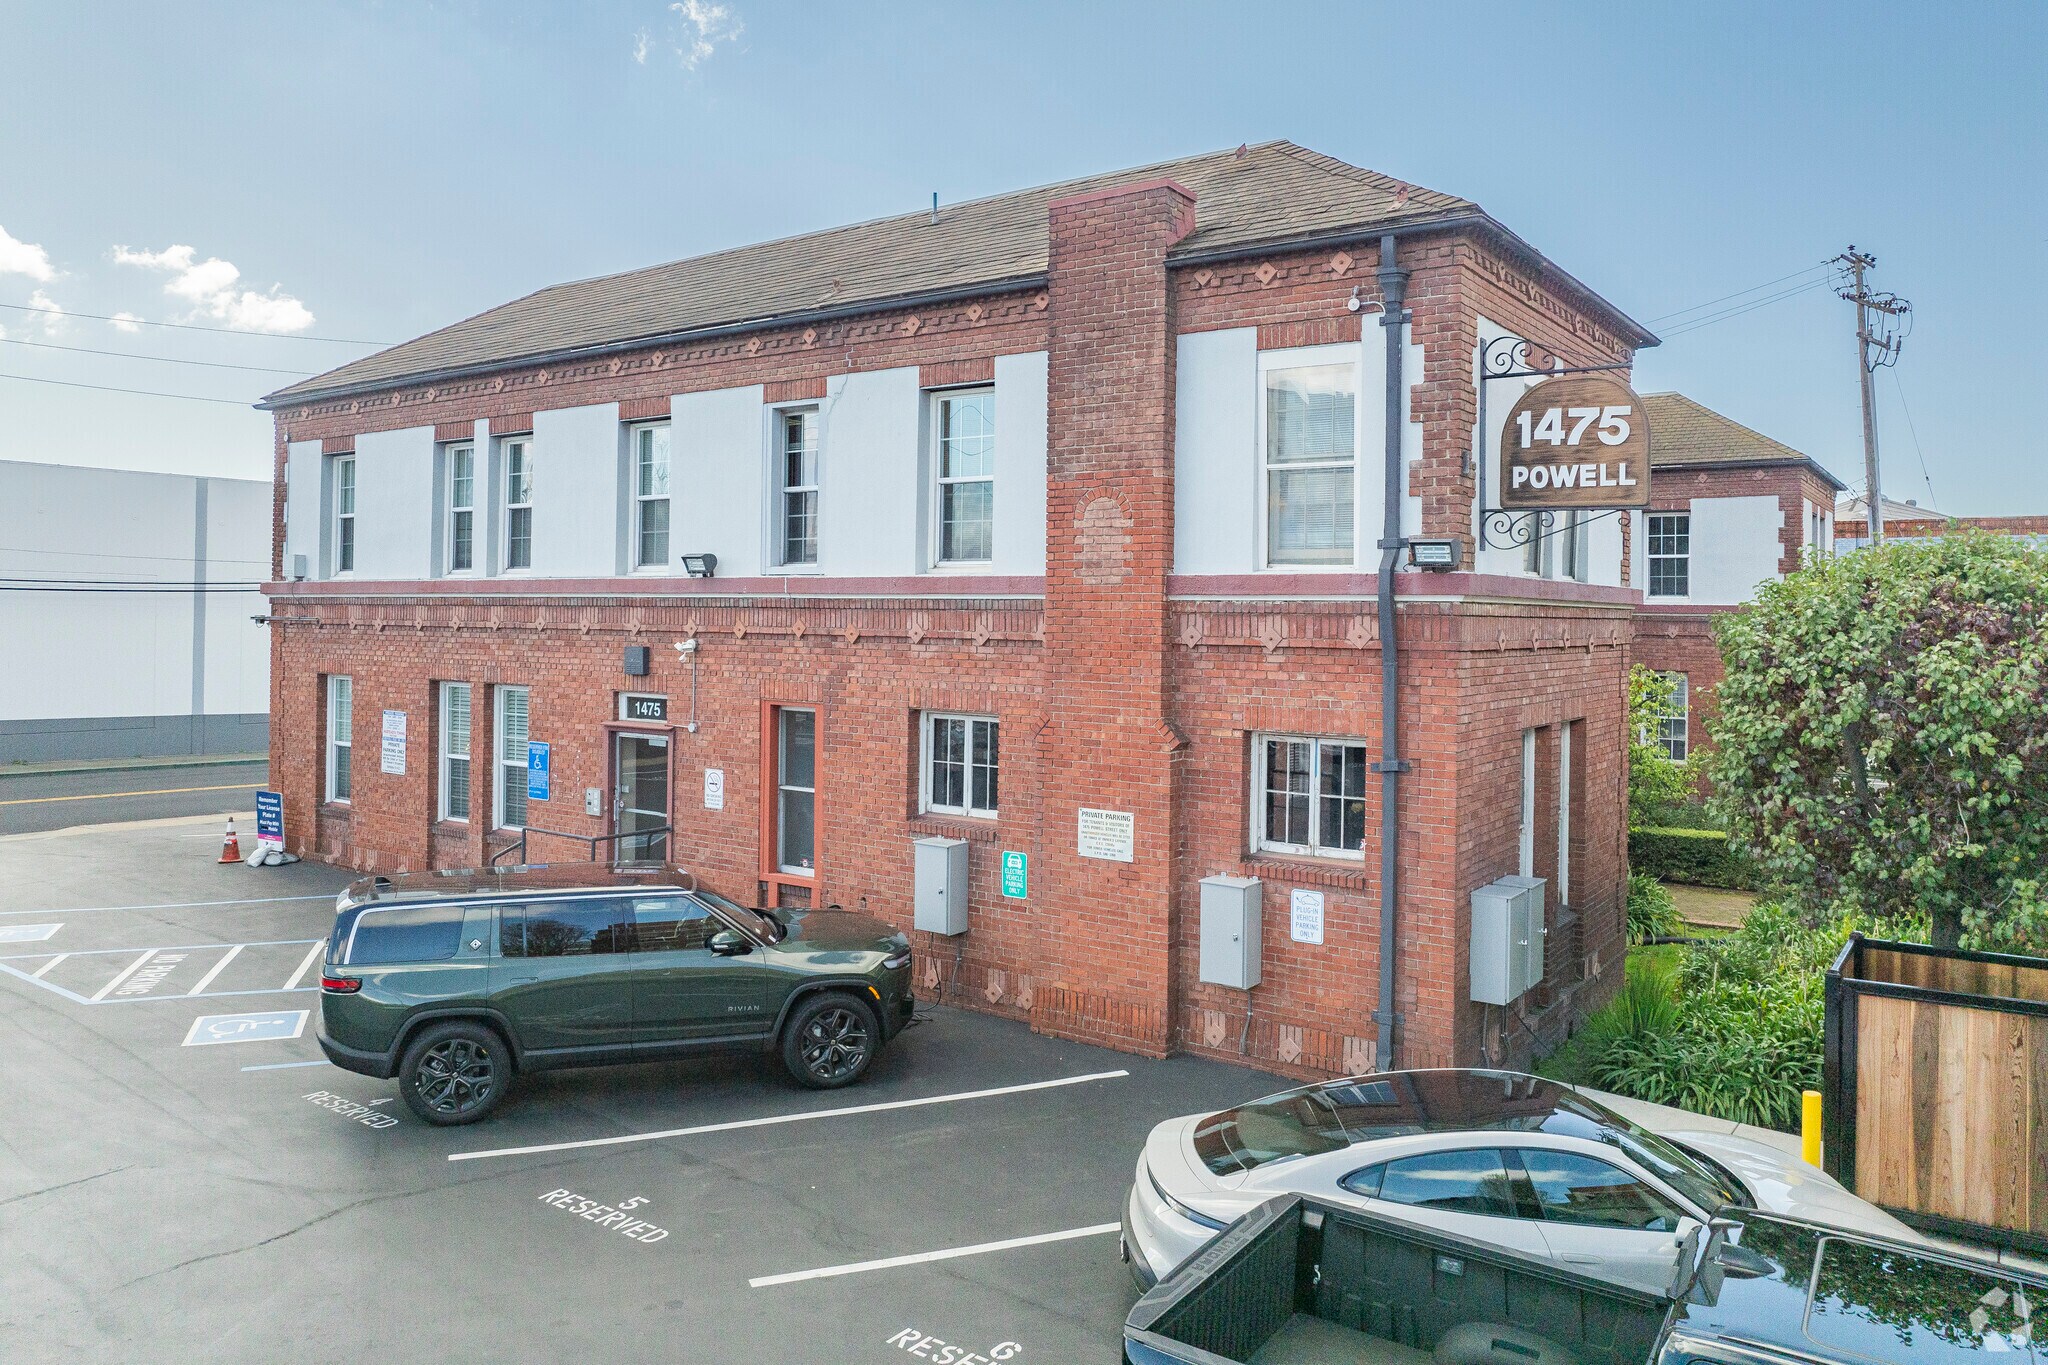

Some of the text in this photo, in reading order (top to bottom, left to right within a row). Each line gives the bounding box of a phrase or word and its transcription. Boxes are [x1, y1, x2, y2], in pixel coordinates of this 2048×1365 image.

[1516, 405, 1632, 449] 1475
[1512, 462, 1637, 489] POWELL
[635, 701, 661, 717] 1475
[1082, 811, 1131, 822] PRIVATE PARKING
[1296, 906, 1319, 915] PLUG-IN
[1296, 914, 1318, 923] VEHICLE
[1296, 922, 1319, 931] PARKING
[301, 1090, 399, 1129] RESERVED
[368, 1098, 394, 1107] 4
[618, 1196, 651, 1210] 5
[538, 1188, 670, 1243] RESERVED
[886, 1327, 1002, 1365] RESE
[990, 1341, 1023, 1360] 6
